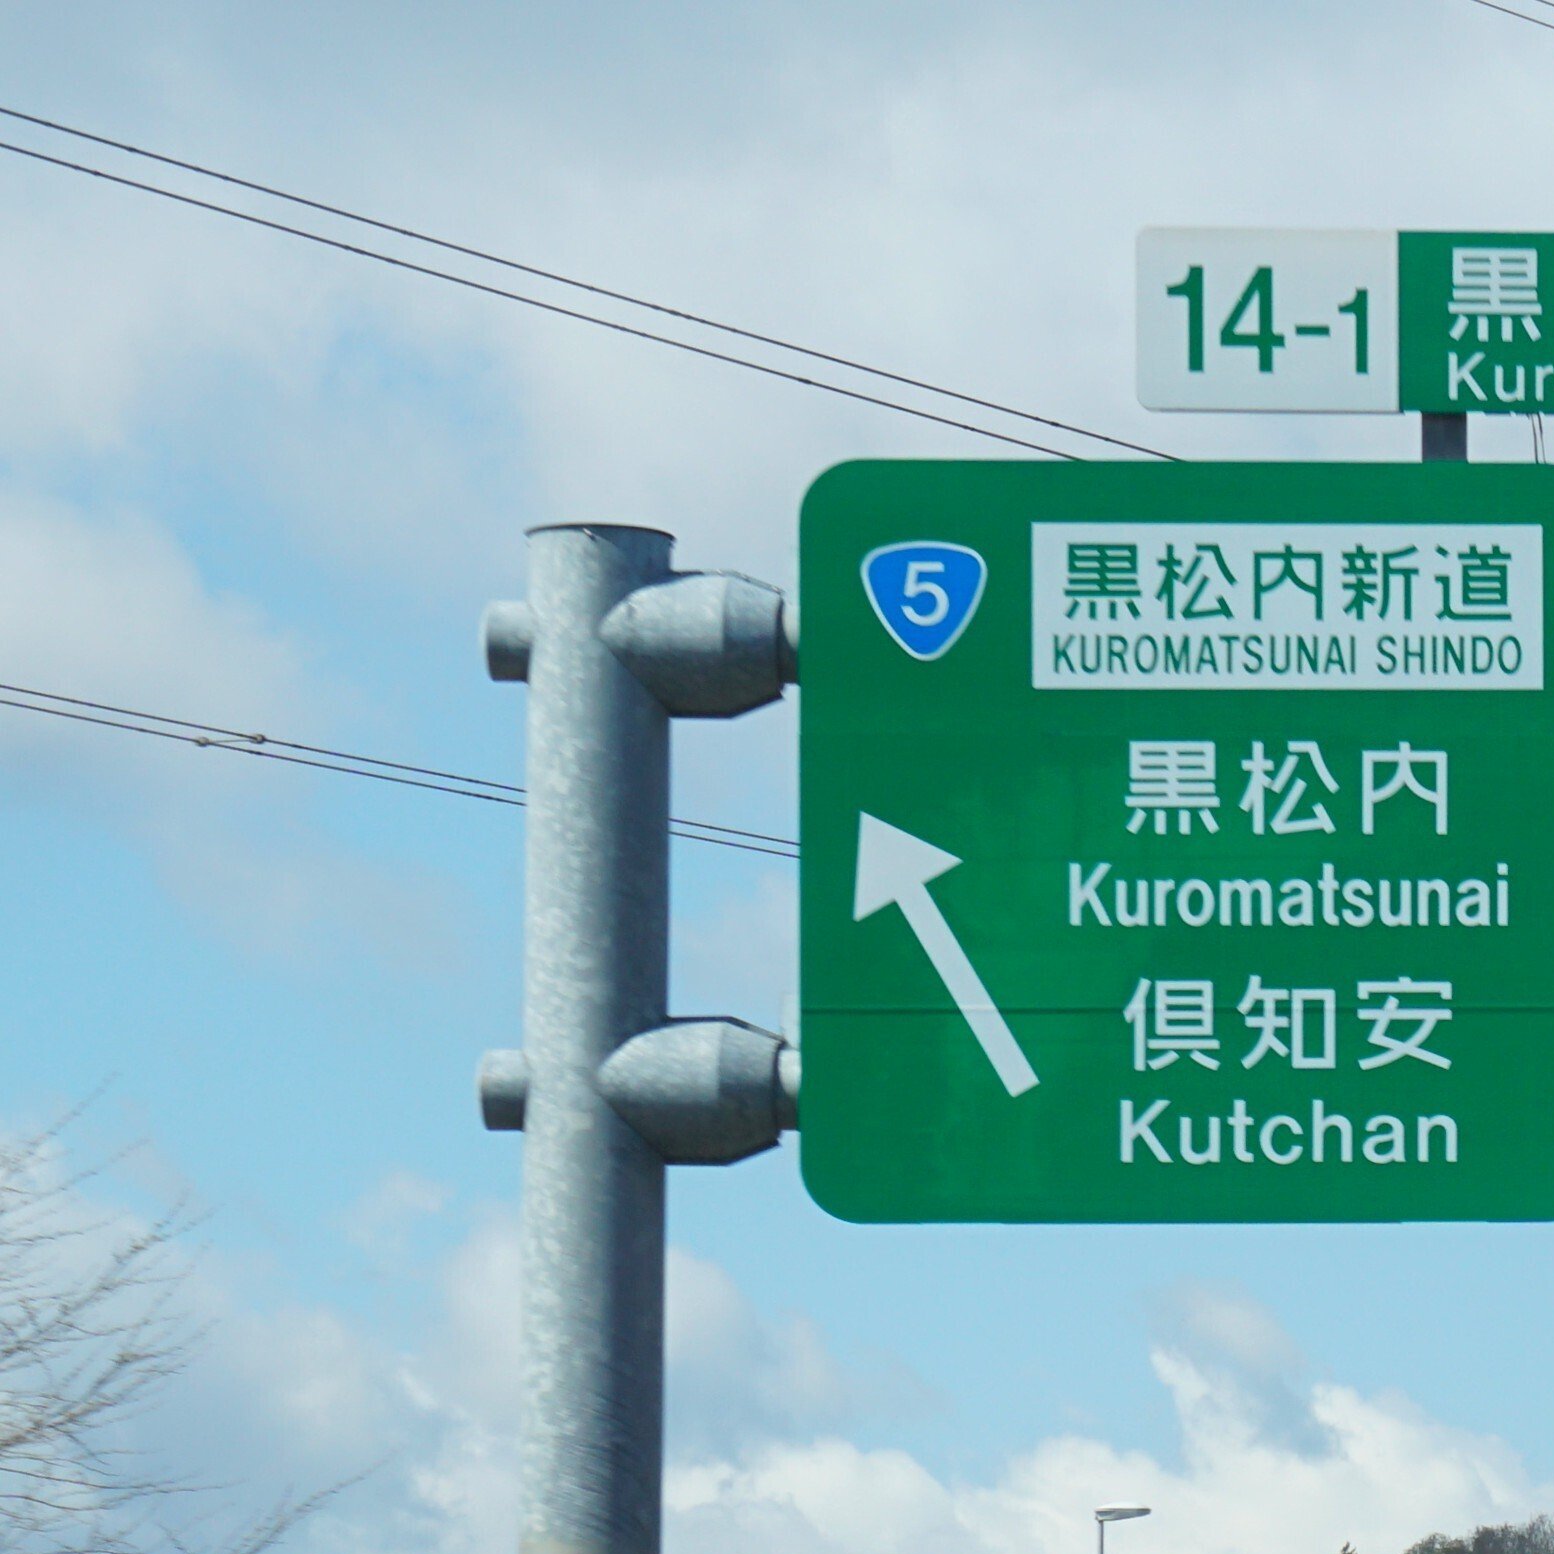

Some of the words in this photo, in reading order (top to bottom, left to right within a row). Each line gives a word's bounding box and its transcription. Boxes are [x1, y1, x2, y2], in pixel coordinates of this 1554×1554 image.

[1166, 265, 1369, 375] 14-1
[900, 560, 949, 627] 5
[1063, 543, 1512, 622] 黒松内新道
[1053, 634, 1356, 676] KUROMATSUNAI
[1376, 635, 1523, 676] SHINDO
[1124, 740, 1448, 836] 黒松内
[1069, 862, 1509, 928] Kuromatsunai
[1123, 975, 1453, 1072] 倶知安
[1120, 1099, 1458, 1165] Kutchan
